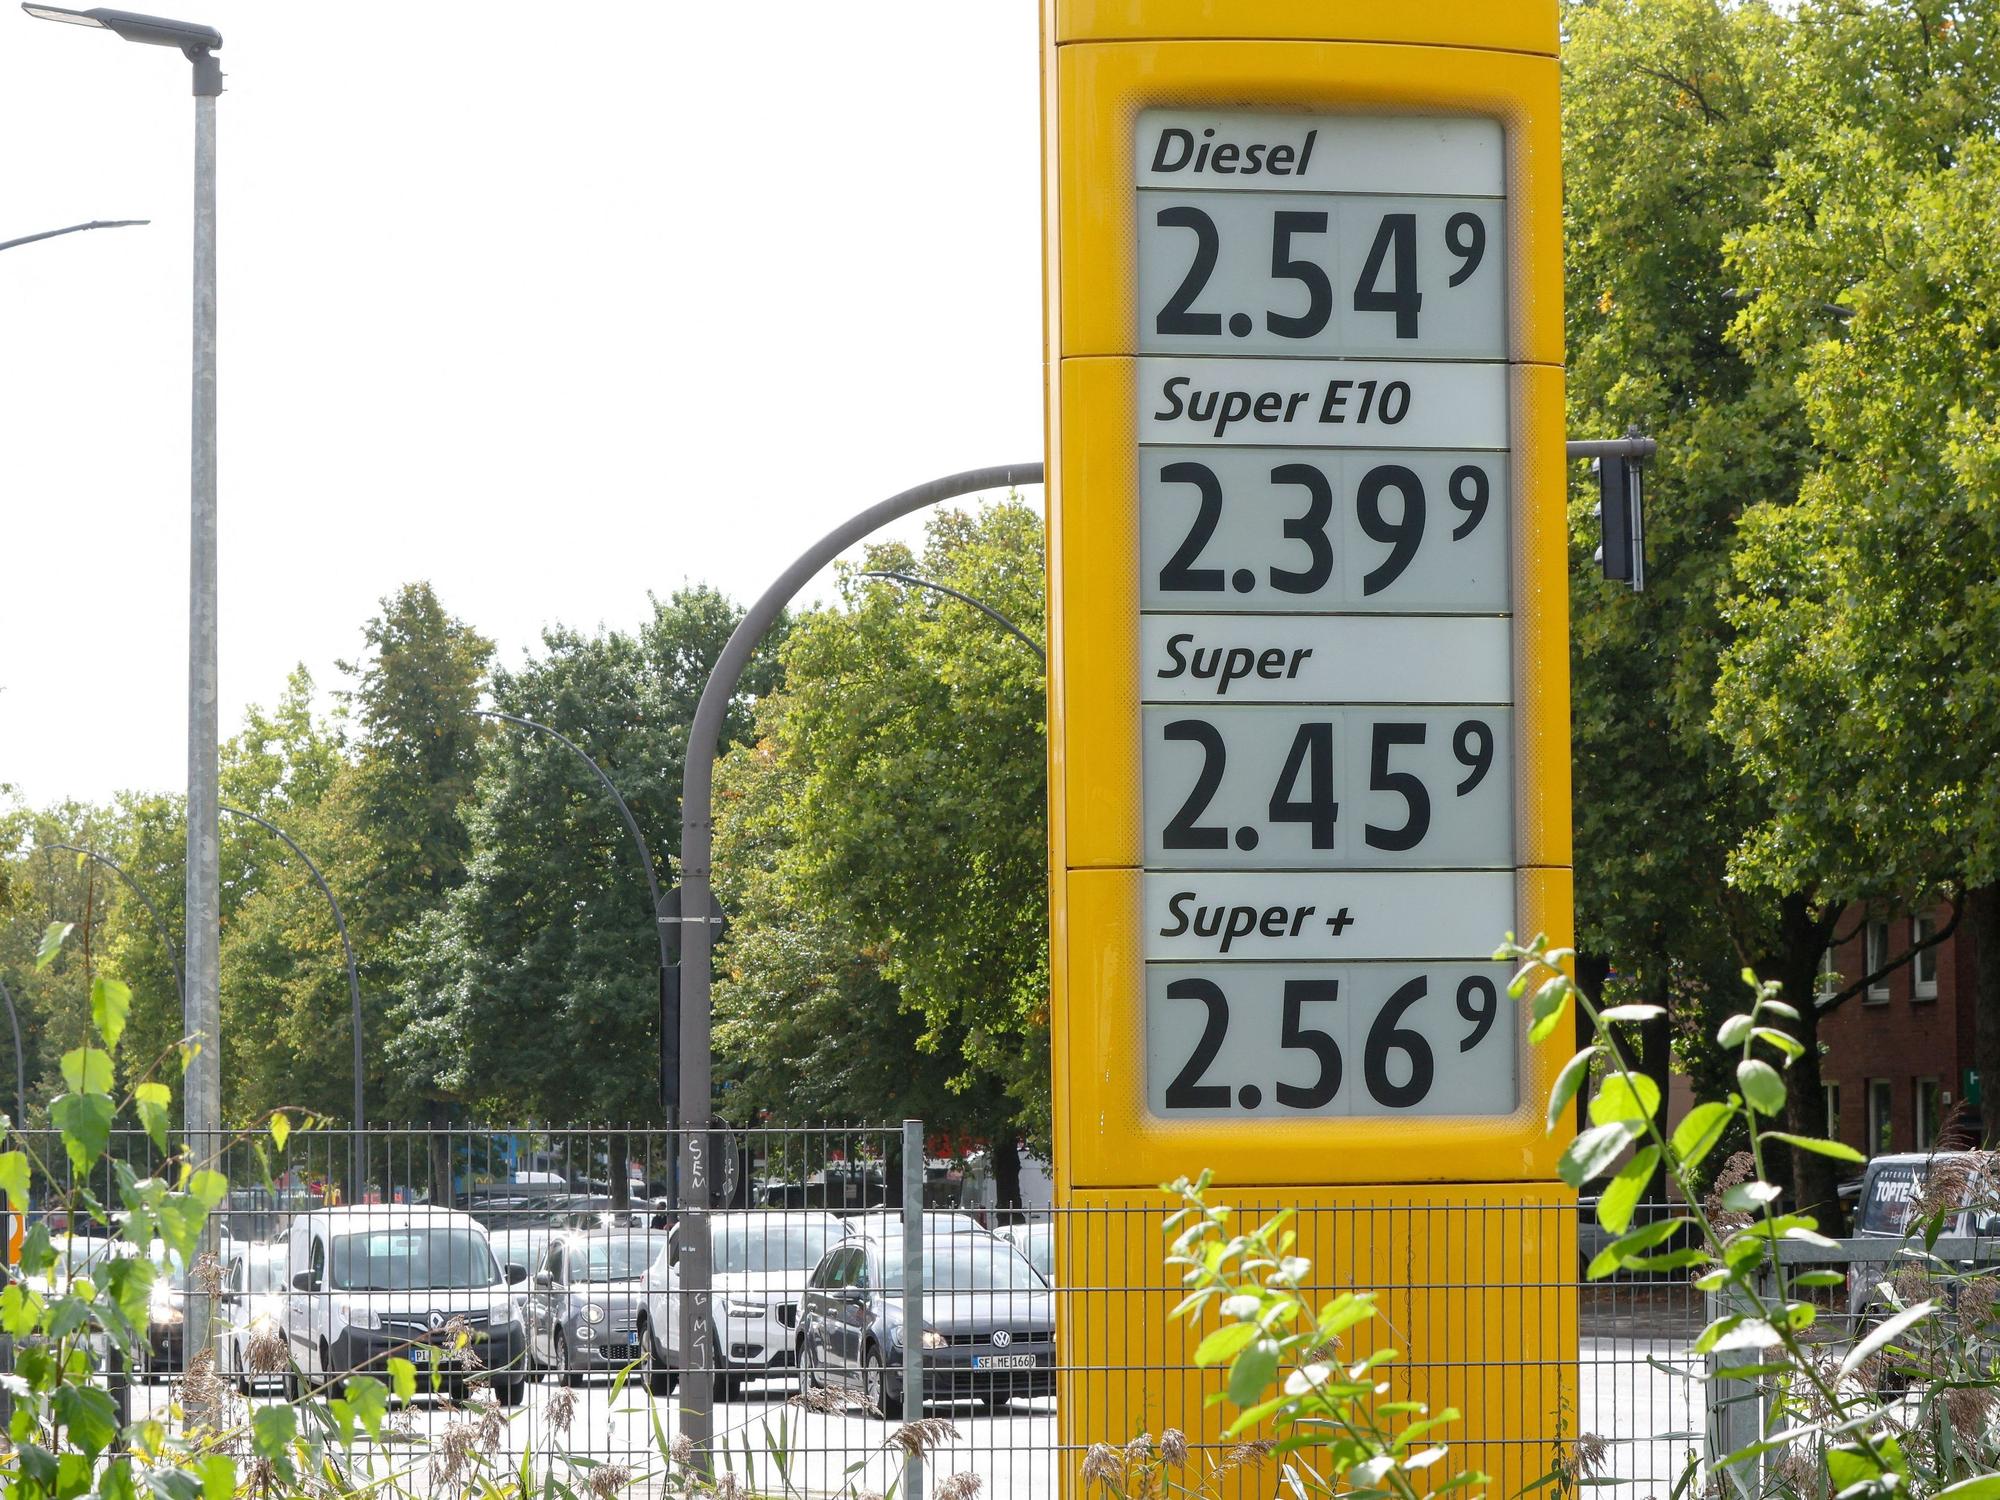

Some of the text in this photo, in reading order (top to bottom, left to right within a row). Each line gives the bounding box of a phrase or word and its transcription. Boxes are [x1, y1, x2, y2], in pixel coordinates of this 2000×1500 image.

[1151, 128, 1318, 176] Diesel
[1155, 206, 1486, 340] 2.549
[1154, 376, 1411, 438] Super E10
[1159, 461, 1490, 597] 2.399
[1157, 633, 1314, 695] Super
[1162, 719, 1494, 852] 2.459
[1159, 891, 1316, 954] Super
[1165, 974, 1498, 1110] 2.569
